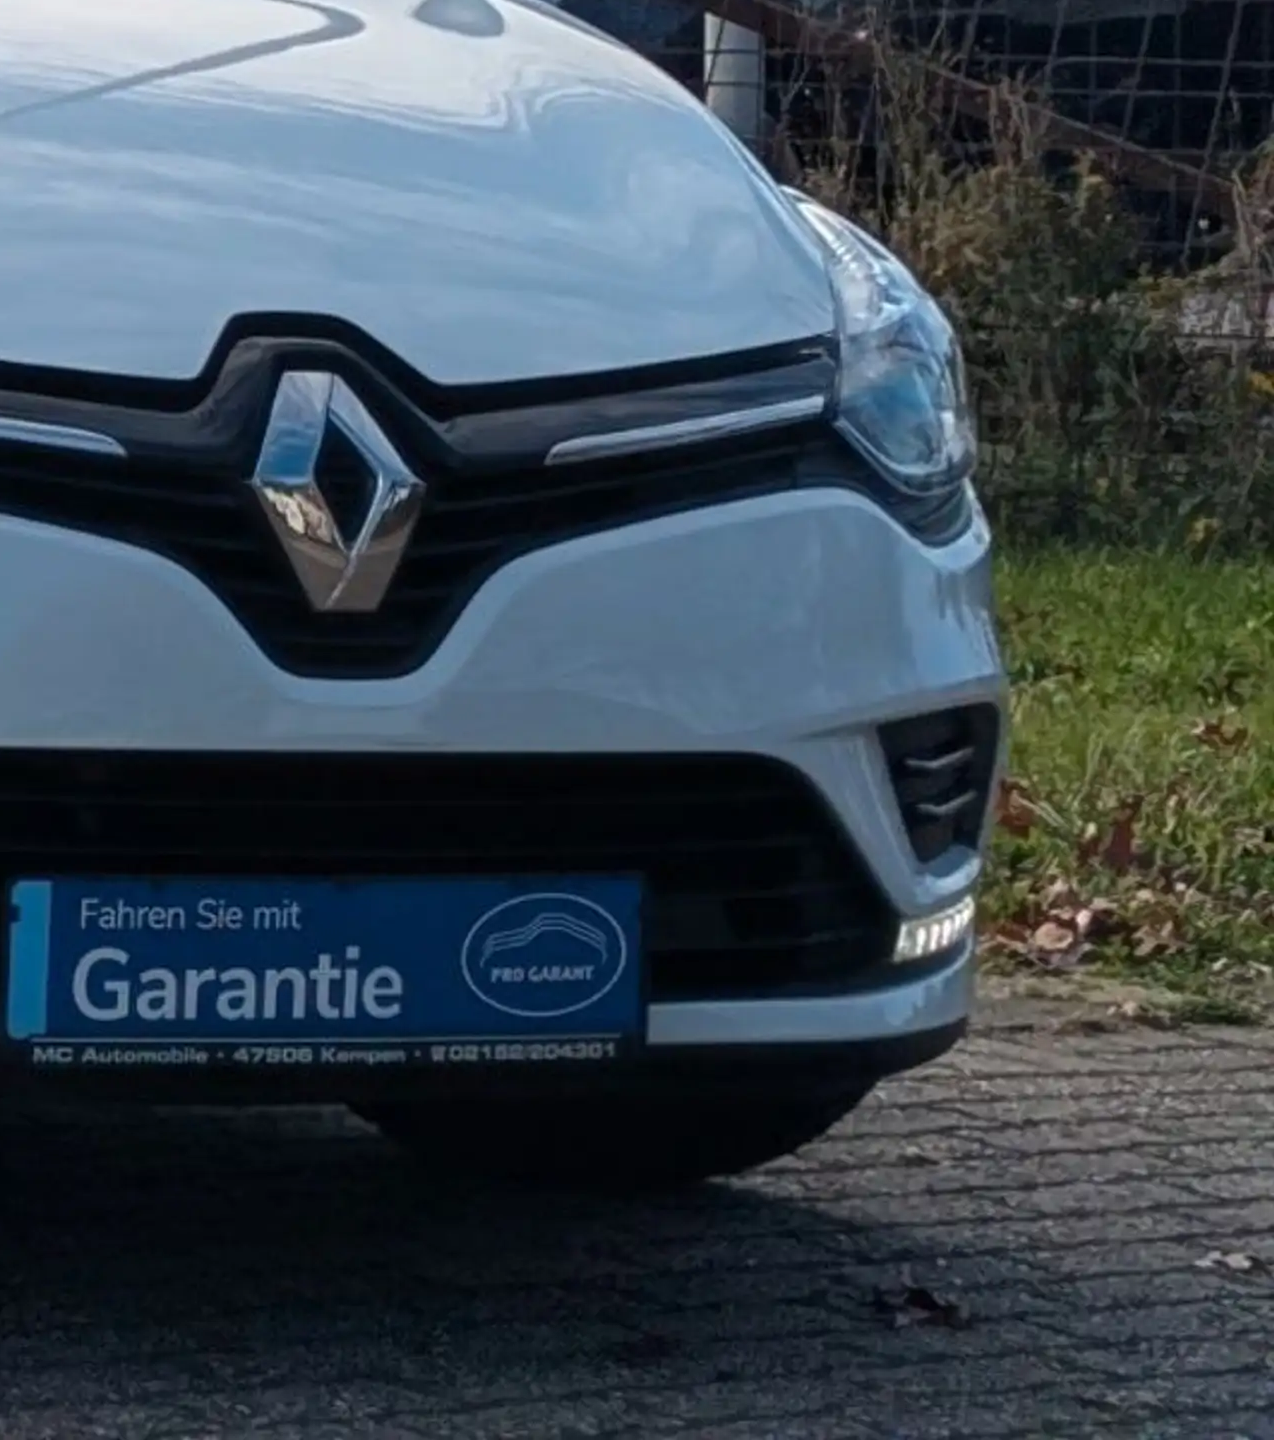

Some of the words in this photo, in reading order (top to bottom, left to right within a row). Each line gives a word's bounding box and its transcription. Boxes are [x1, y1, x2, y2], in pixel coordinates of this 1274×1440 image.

[79, 898, 186, 930] Fahren
[195, 897, 244, 930] Sie
[252, 899, 303, 930] mit
[71, 945, 404, 1022] Garantie
[490, 966, 526, 984] PRO
[528, 964, 596, 982] GARANT
[31, 1046, 74, 1064] MC
[82, 1046, 209, 1065] Automobile
[320, 1045, 407, 1067] Kempen
